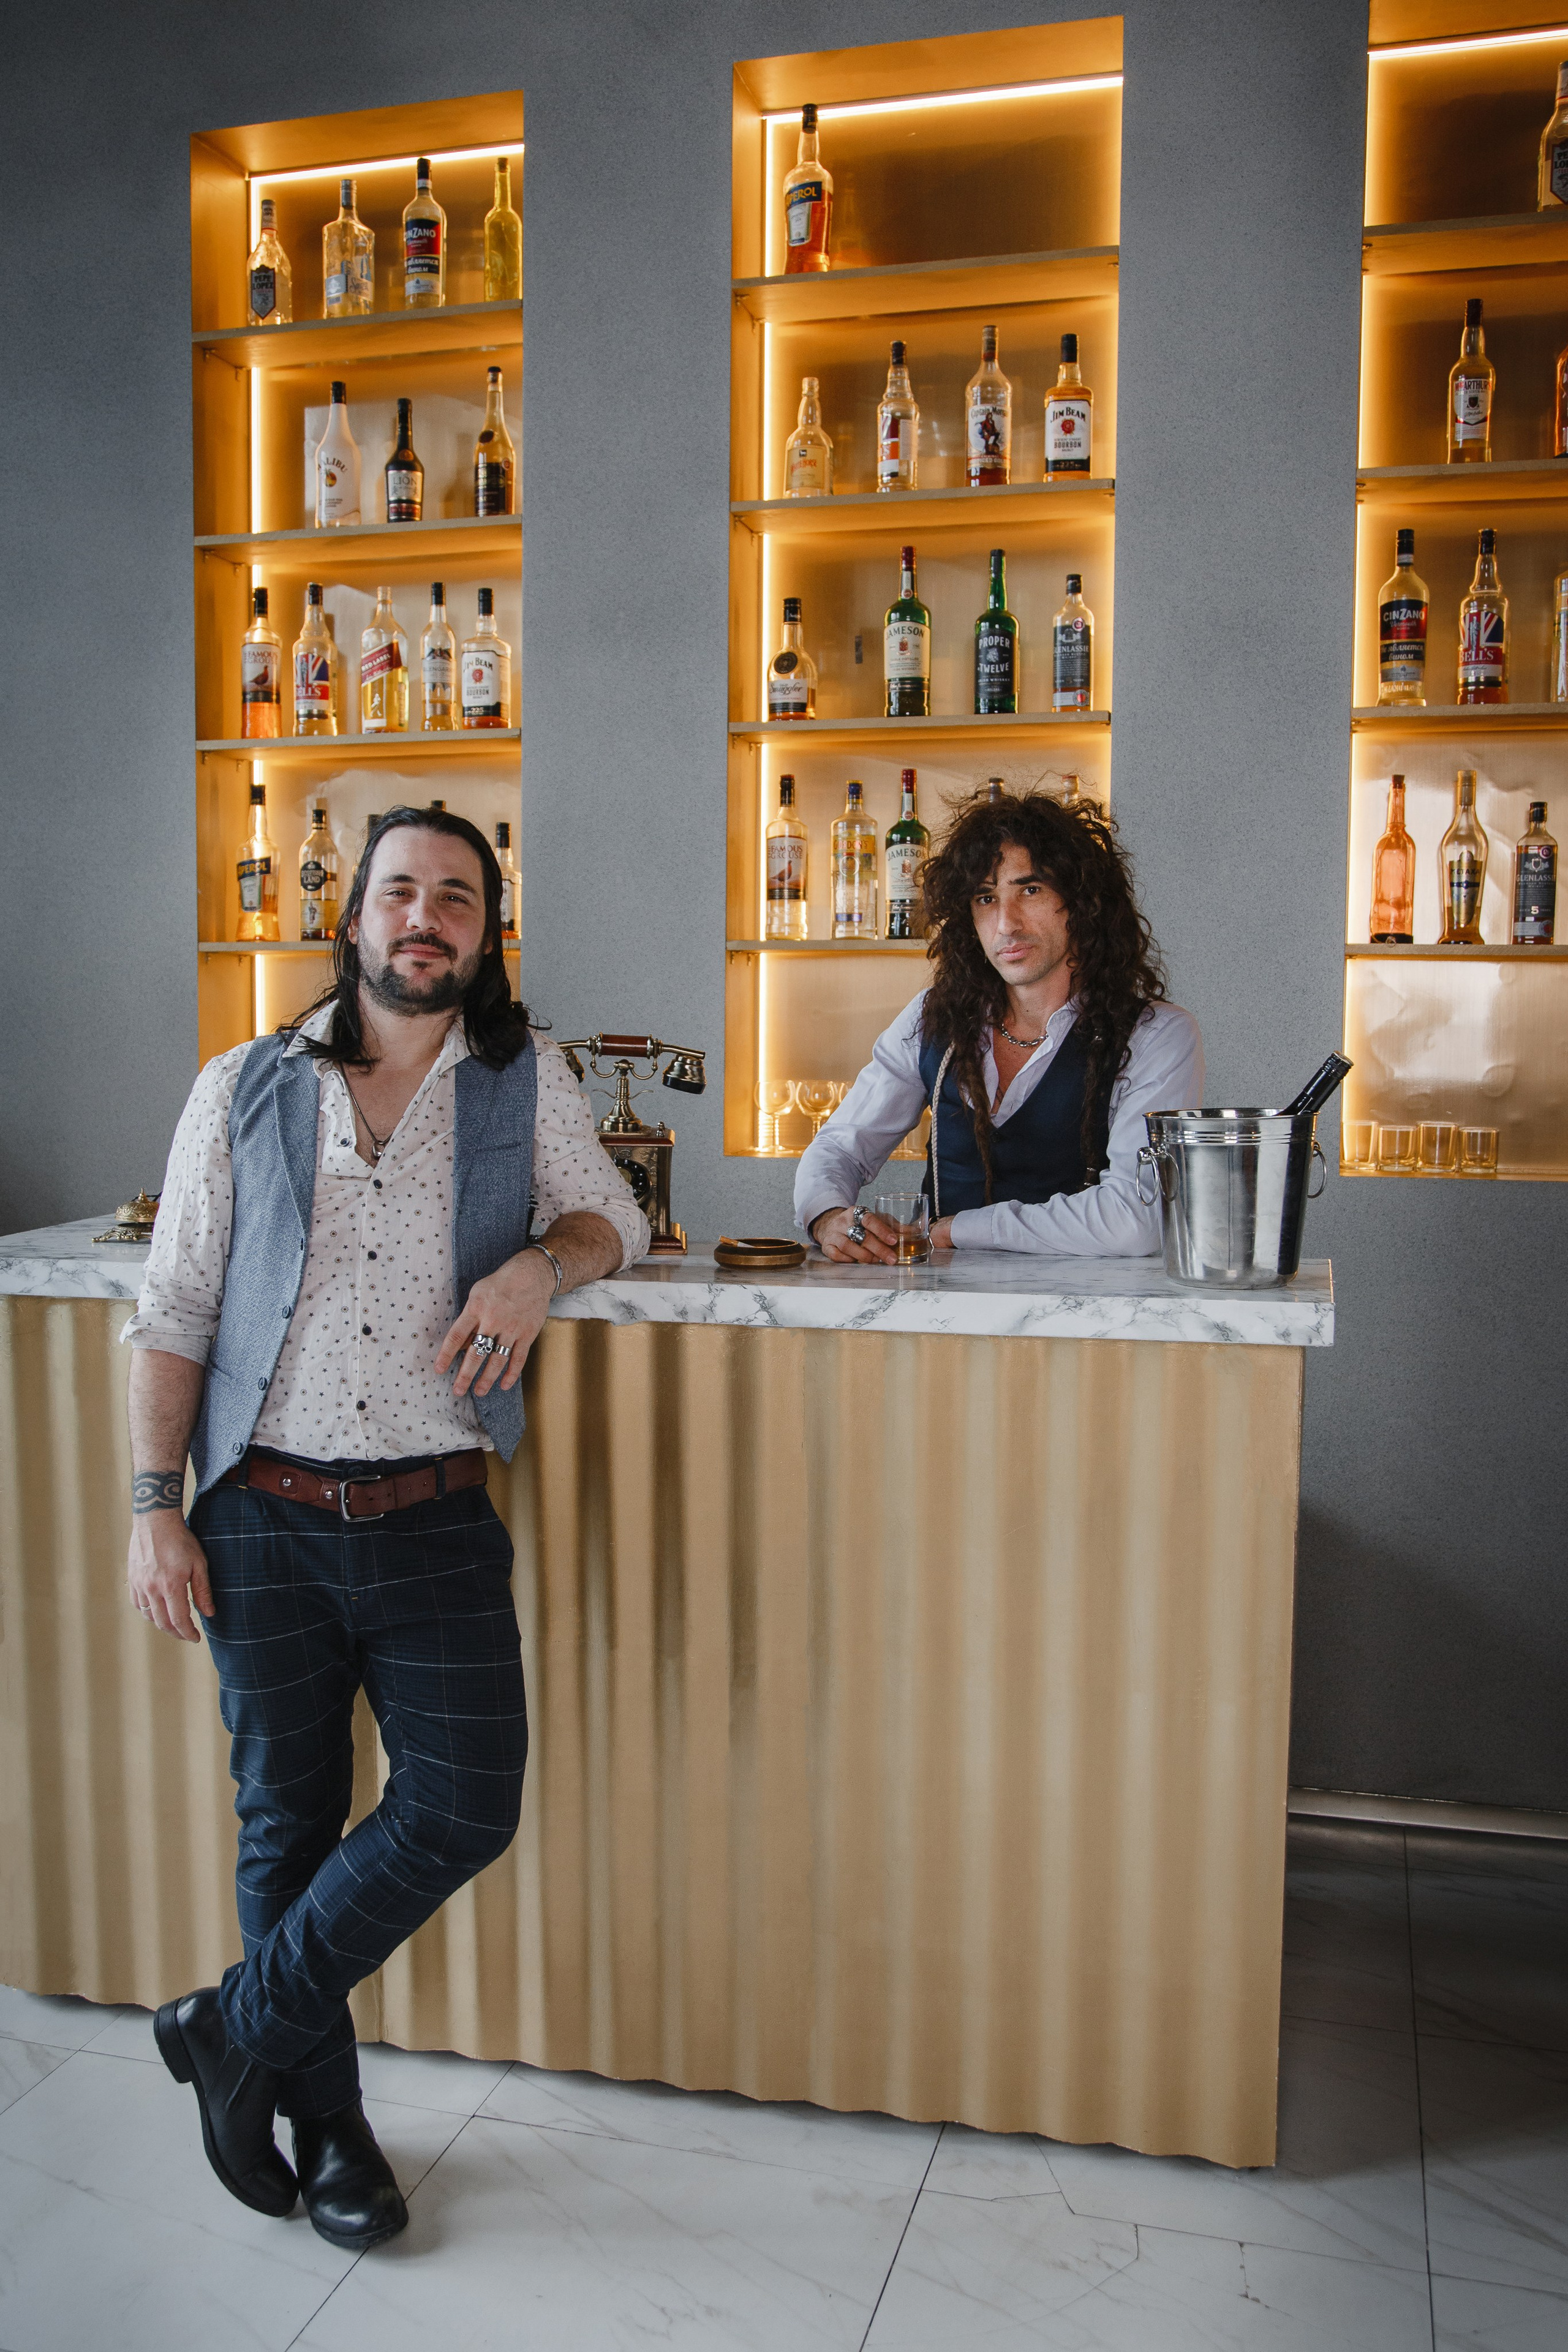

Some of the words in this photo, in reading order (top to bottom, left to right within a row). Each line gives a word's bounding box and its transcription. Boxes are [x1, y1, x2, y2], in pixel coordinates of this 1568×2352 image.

[253, 282, 273, 290] LOPEZ
[1050, 410, 1063, 423] JIM
[1066, 407, 1086, 421] BEAM
[318, 458, 348, 472] ALIBU
[1383, 608, 1424, 622] CINZANO
[886, 626, 925, 641] JAMESON
[979, 635, 1010, 649] PROPER
[1054, 645, 1089, 654] LENLASSIE
[1459, 648, 1494, 663] BELL'S
[373, 654, 391, 665] LABEL
[475, 657, 493, 671] BEAM
[979, 662, 1009, 674] TWELVE
[296, 684, 321, 696] ELL'S
[834, 840, 867, 850] GORDON'S
[888, 848, 923, 861] JAMESO
[1531, 906, 1539, 914] 5
